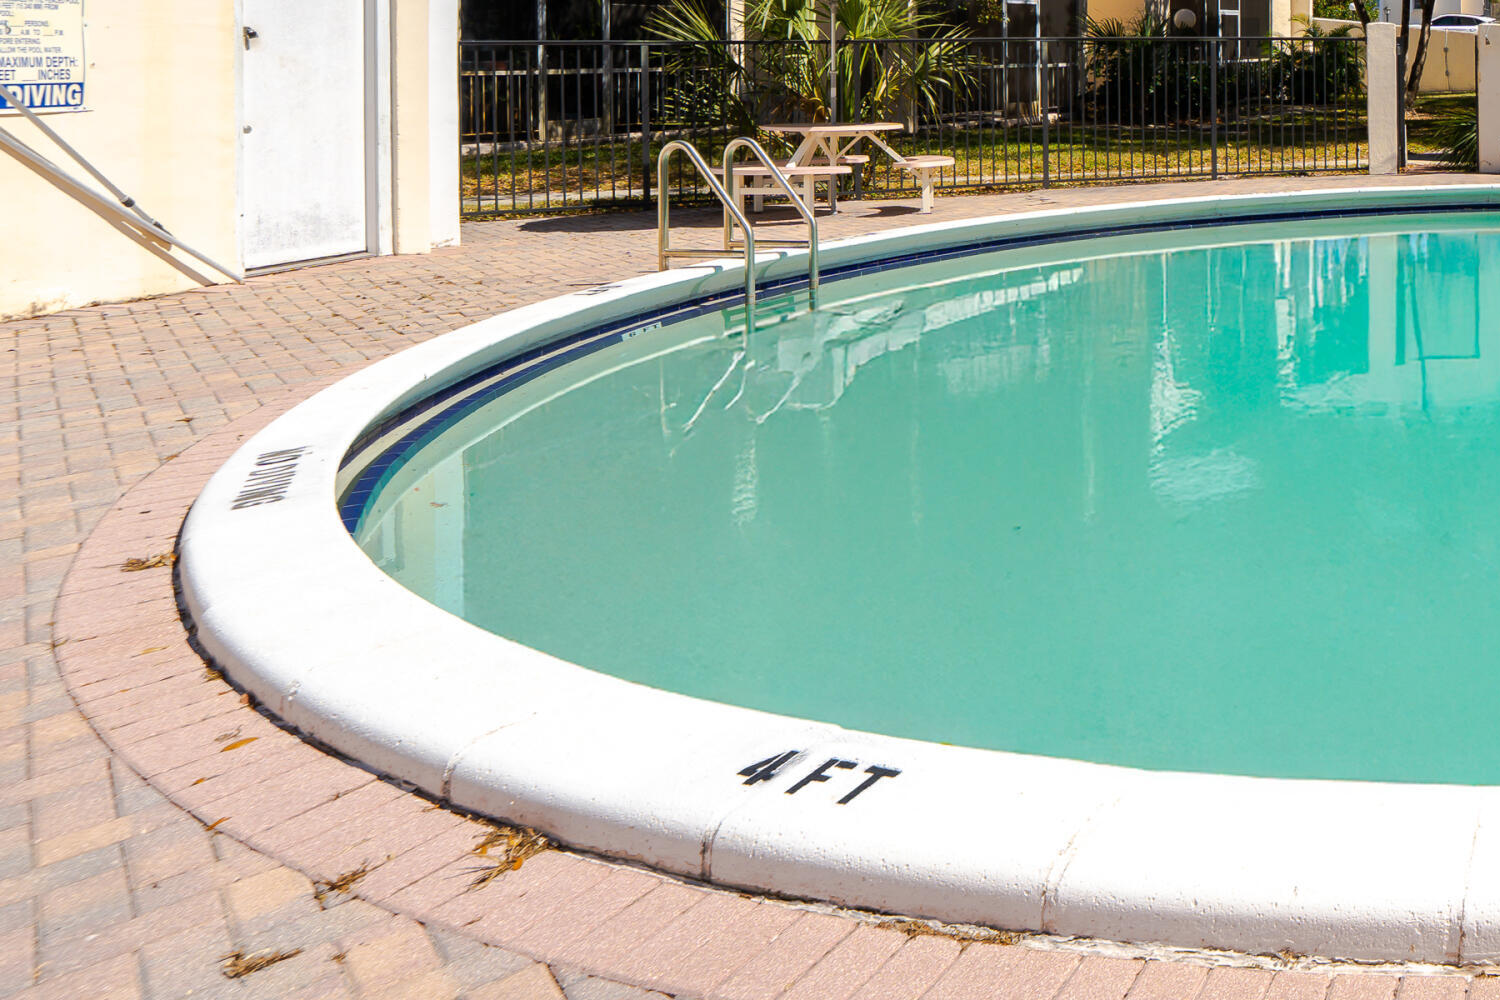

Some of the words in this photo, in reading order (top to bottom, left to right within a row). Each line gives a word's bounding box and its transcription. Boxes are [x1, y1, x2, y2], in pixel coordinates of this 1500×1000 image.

[0, 56, 43, 67] MAXIMUM
[46, 56, 79, 67] DEPTH:
[38, 69, 71, 80] INCHES
[6, 83, 82, 107] DIVING
[230, 462, 300, 511] DIVING
[736, 750, 801, 786] 4
[784, 757, 902, 805] FT
